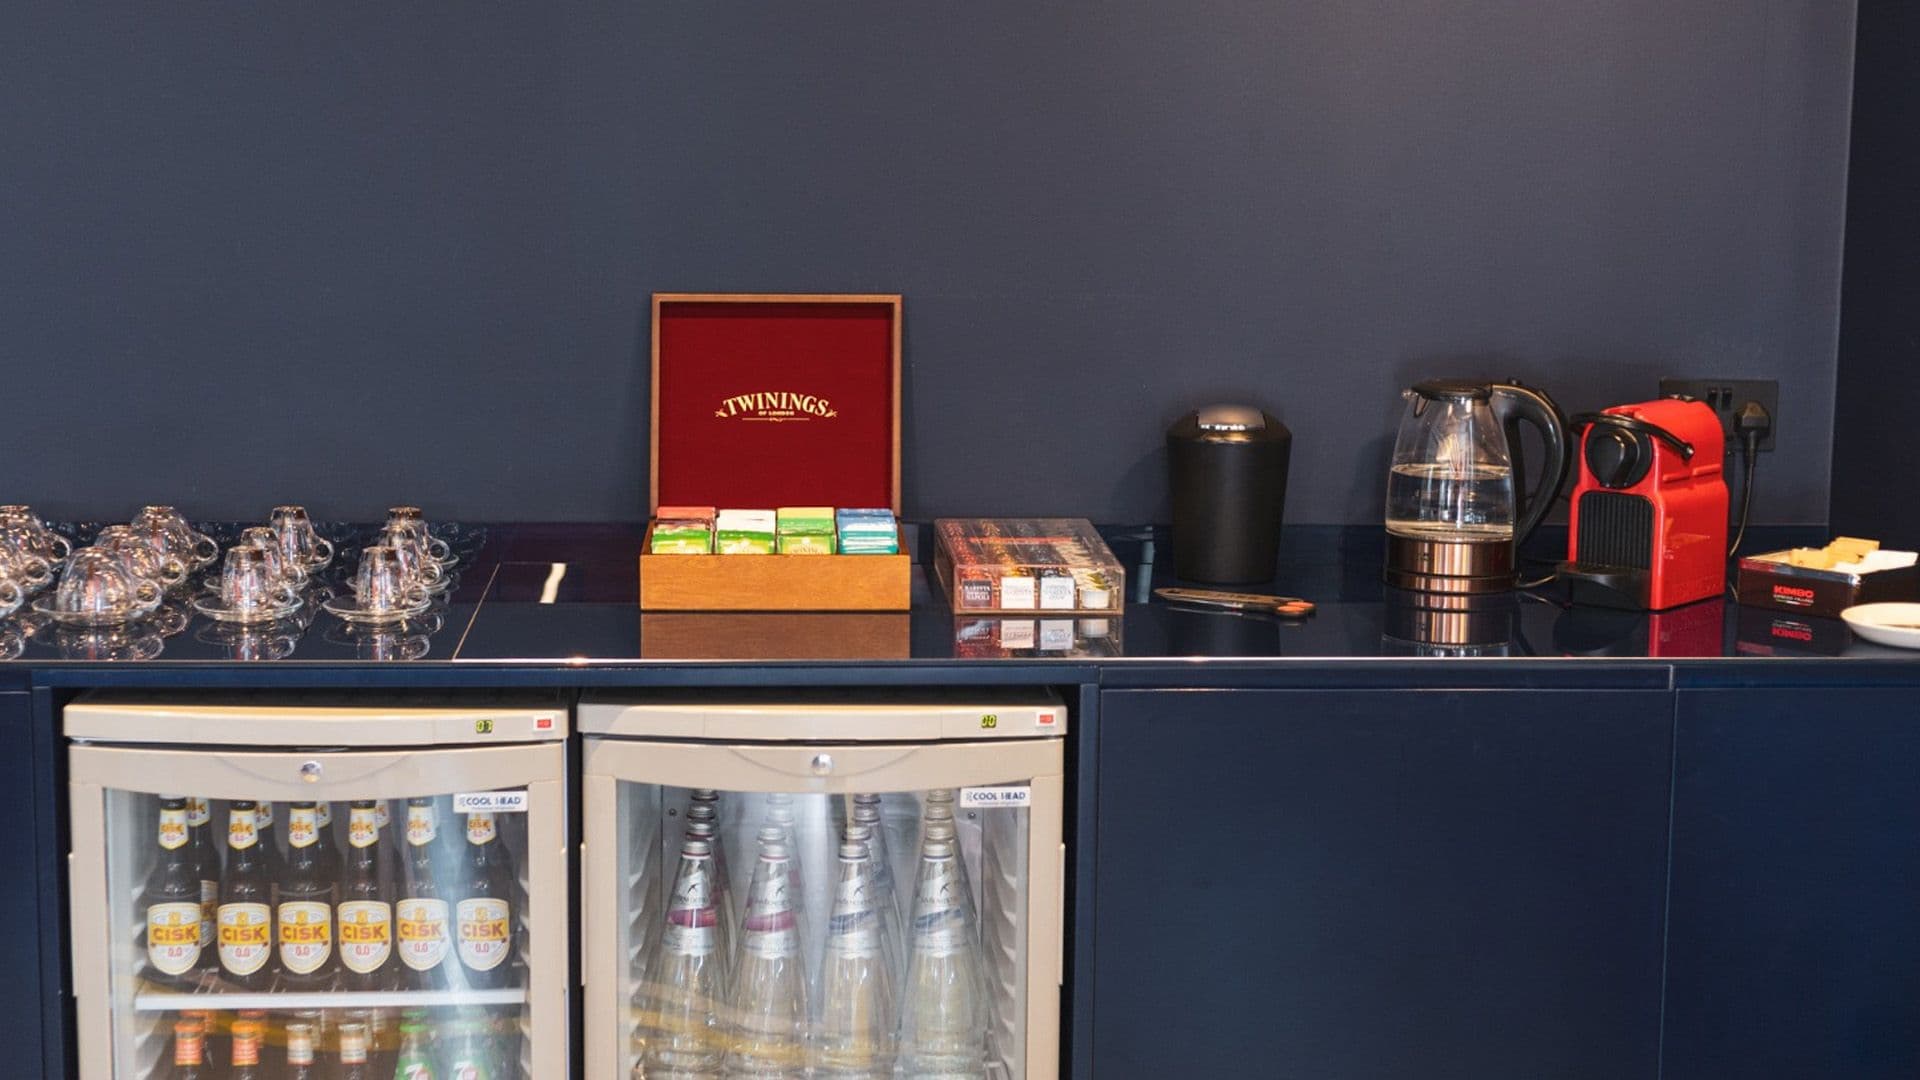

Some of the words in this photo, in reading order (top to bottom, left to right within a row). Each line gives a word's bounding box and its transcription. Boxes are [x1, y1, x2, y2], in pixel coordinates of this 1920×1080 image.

[723, 392, 829, 416] TWININGS
[1773, 585, 1814, 598] KIMBO
[466, 797, 492, 806] COOL
[973, 792, 997, 801] COOL
[153, 926, 197, 941] CISK
[222, 927, 265, 941] CISK
[282, 925, 324, 940] CISK
[343, 925, 385, 940] CISK
[400, 922, 442, 937] CISK
[461, 922, 504, 937] CISK
